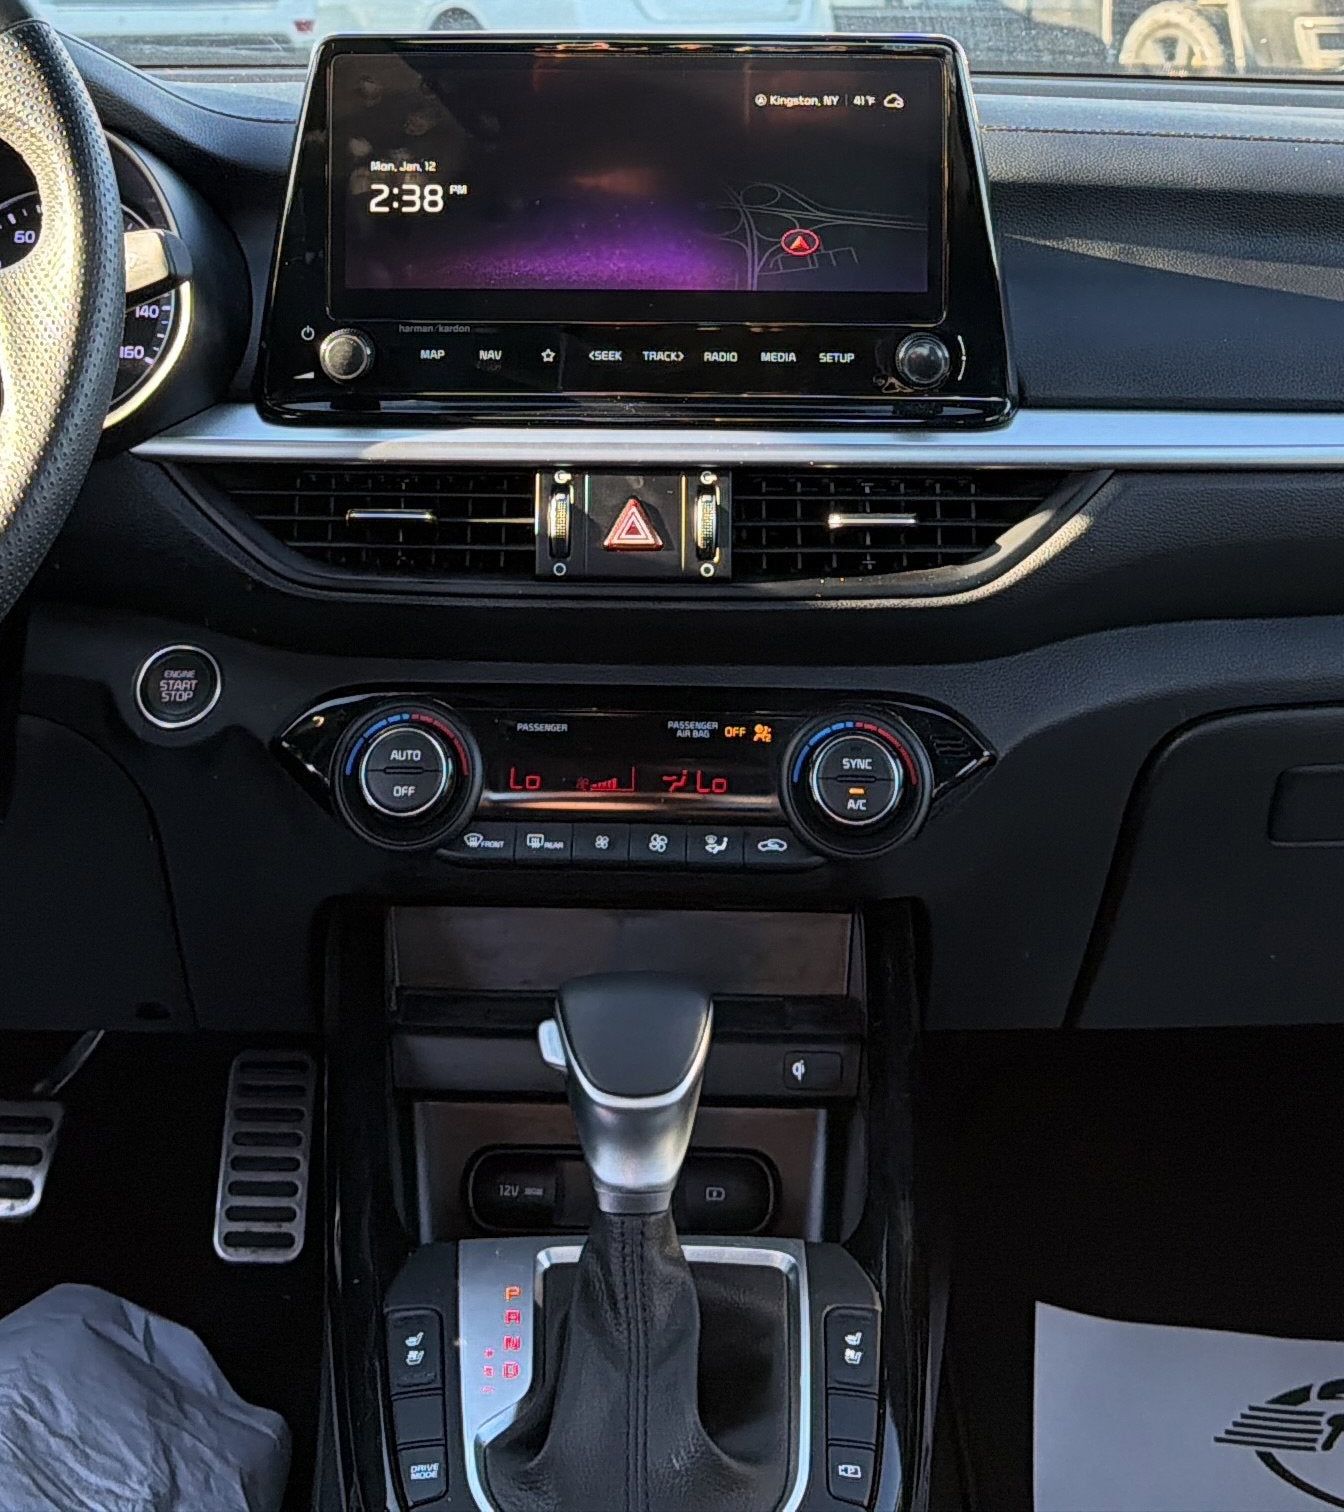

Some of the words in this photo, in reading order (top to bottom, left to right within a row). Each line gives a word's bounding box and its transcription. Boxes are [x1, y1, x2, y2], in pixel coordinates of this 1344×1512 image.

[769, 94, 822, 107] Kingston,
[823, 94, 840, 106] NY
[424, 161, 437, 172] 12
[369, 183, 444, 213] 2:38
[449, 184, 468, 195] PM
[13, 230, 36, 244] 60
[134, 305, 160, 319] 140
[119, 346, 145, 359] 160
[419, 349, 446, 360] MAP
[478, 349, 503, 361] NAV
[703, 351, 739, 363] RADIO
[760, 351, 797, 363] MEDIA
[818, 352, 855, 364] SETUP
[164, 670, 196, 678] ENGINE
[159, 679, 198, 691] START
[160, 691, 194, 702] STOP
[517, 722, 568, 732] PASSENGER
[667, 721, 719, 730] PASSENGER
[676, 729, 691, 738] AIR
[692, 729, 710, 738] BAG
[724, 726, 747, 738] OFF
[389, 749, 422, 761] AUTO
[842, 757, 873, 770] SYNC
[392, 785, 416, 797] OFF
[846, 799, 867, 810] A/C
[499, 1184, 520, 1198] 12V
[504, 1286, 521, 1302] P
[503, 1335, 522, 1350] N
[502, 1361, 520, 1379] D
